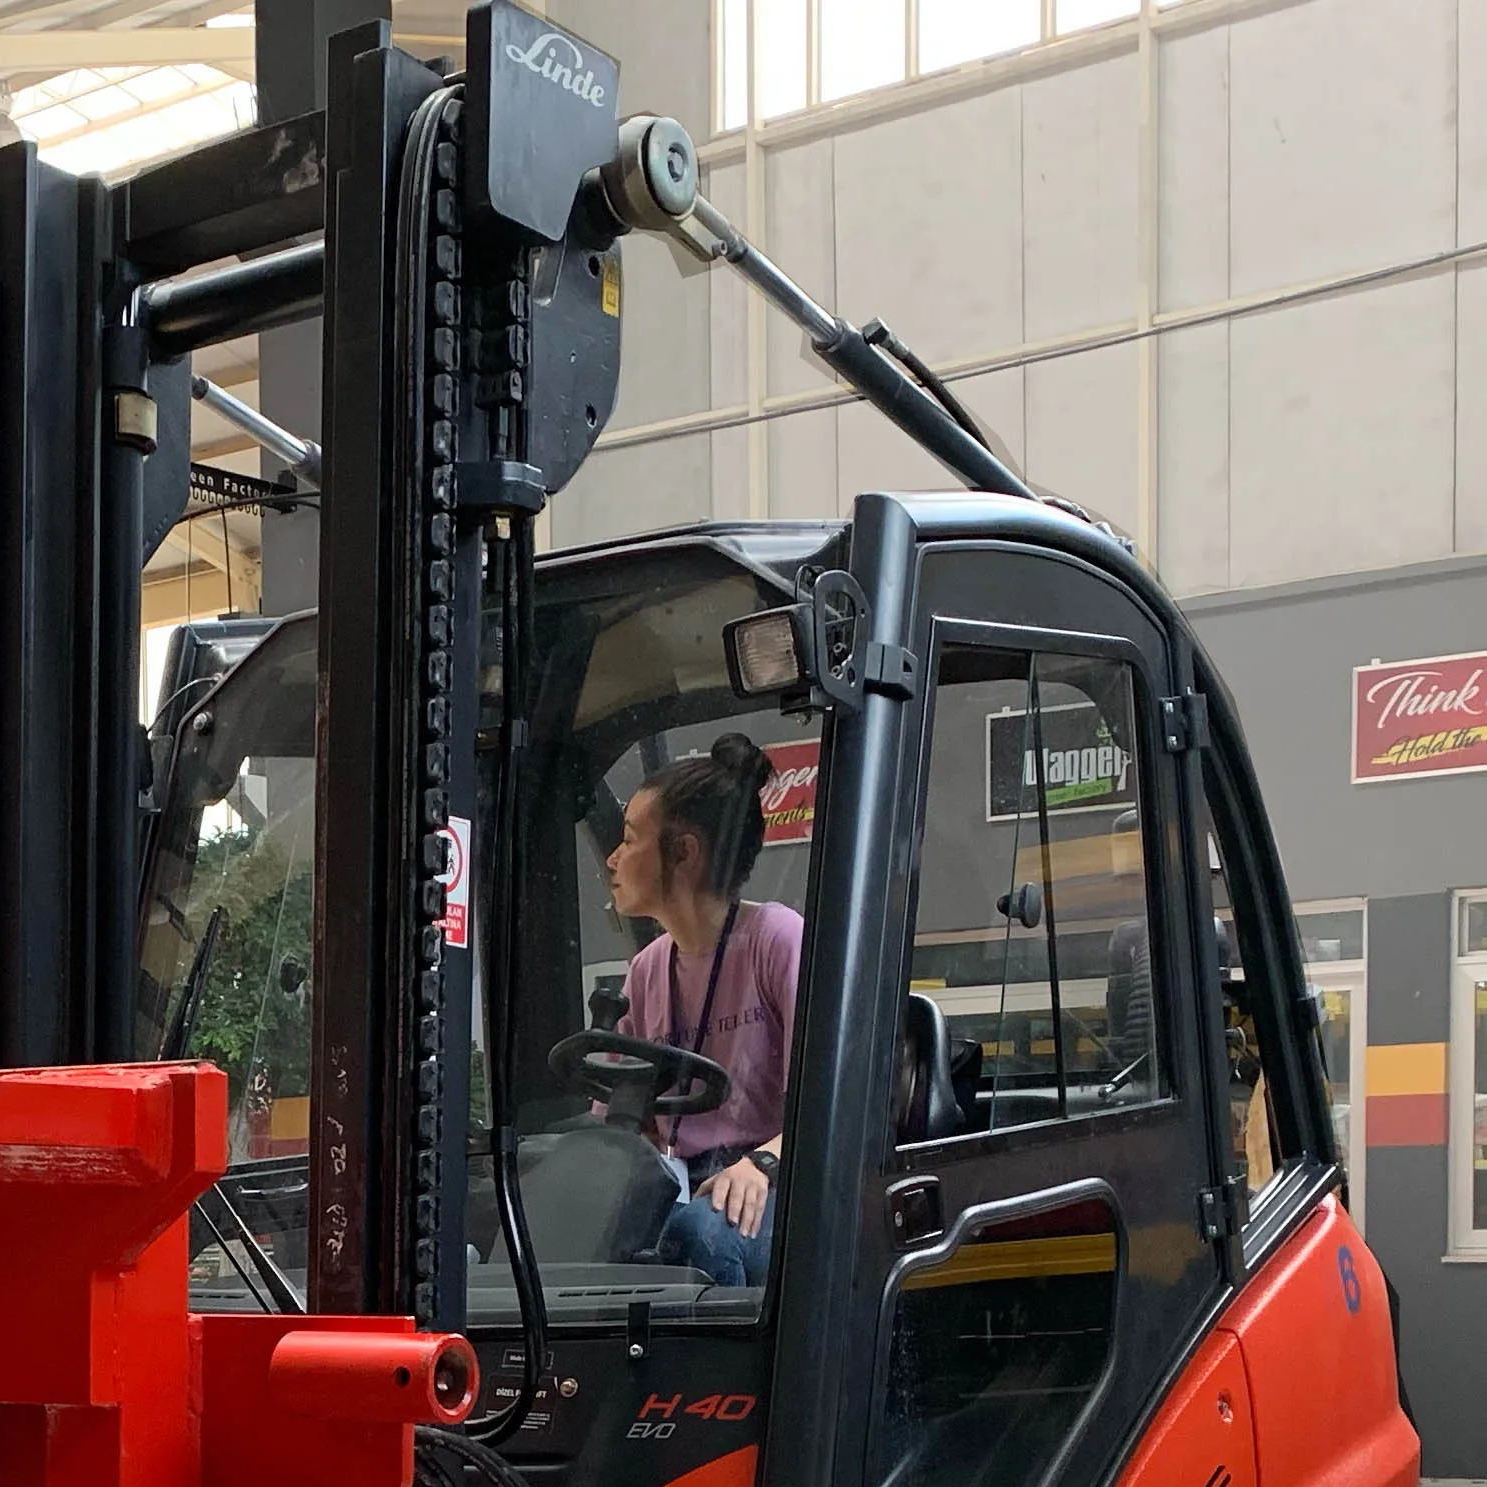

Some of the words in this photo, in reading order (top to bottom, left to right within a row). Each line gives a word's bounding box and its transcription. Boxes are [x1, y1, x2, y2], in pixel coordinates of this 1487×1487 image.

[505, 33, 605, 107] Linde
[190, 471, 214, 487] een
[224, 477, 269, 497] Factor
[1366, 669, 1483, 729] Think
[1392, 735, 1444, 767] Hold
[758, 765, 819, 811] gger
[637, 1393, 683, 1420] H
[684, 1393, 757, 1421] 40
[626, 1422, 677, 1439] EVO
